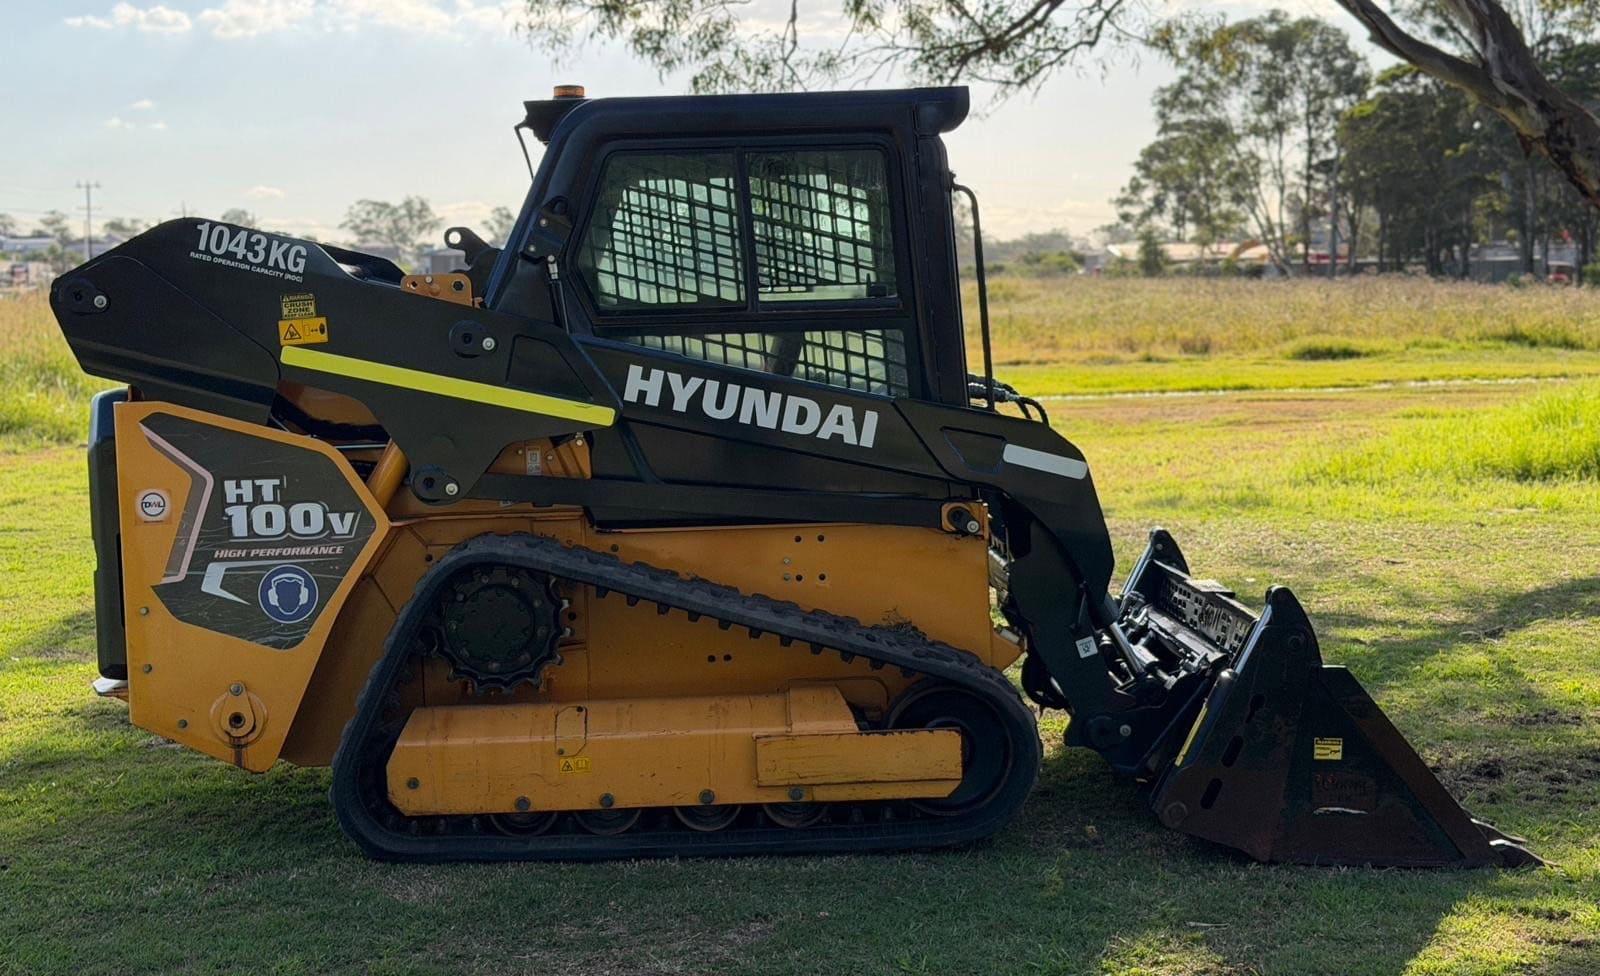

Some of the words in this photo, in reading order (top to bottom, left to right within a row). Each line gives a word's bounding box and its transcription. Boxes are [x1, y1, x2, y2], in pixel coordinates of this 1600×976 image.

[190, 251, 212, 262] RATED
[212, 257, 250, 271] OPERATION
[251, 265, 284, 278] CAPACITY
[284, 301, 313, 309] CRUSH
[623, 364, 879, 449] HYUNDAI
[223, 479, 281, 504] HT
[213, 549, 247, 559] HIGH
[250, 545, 345, 557] PERFORMANCE
